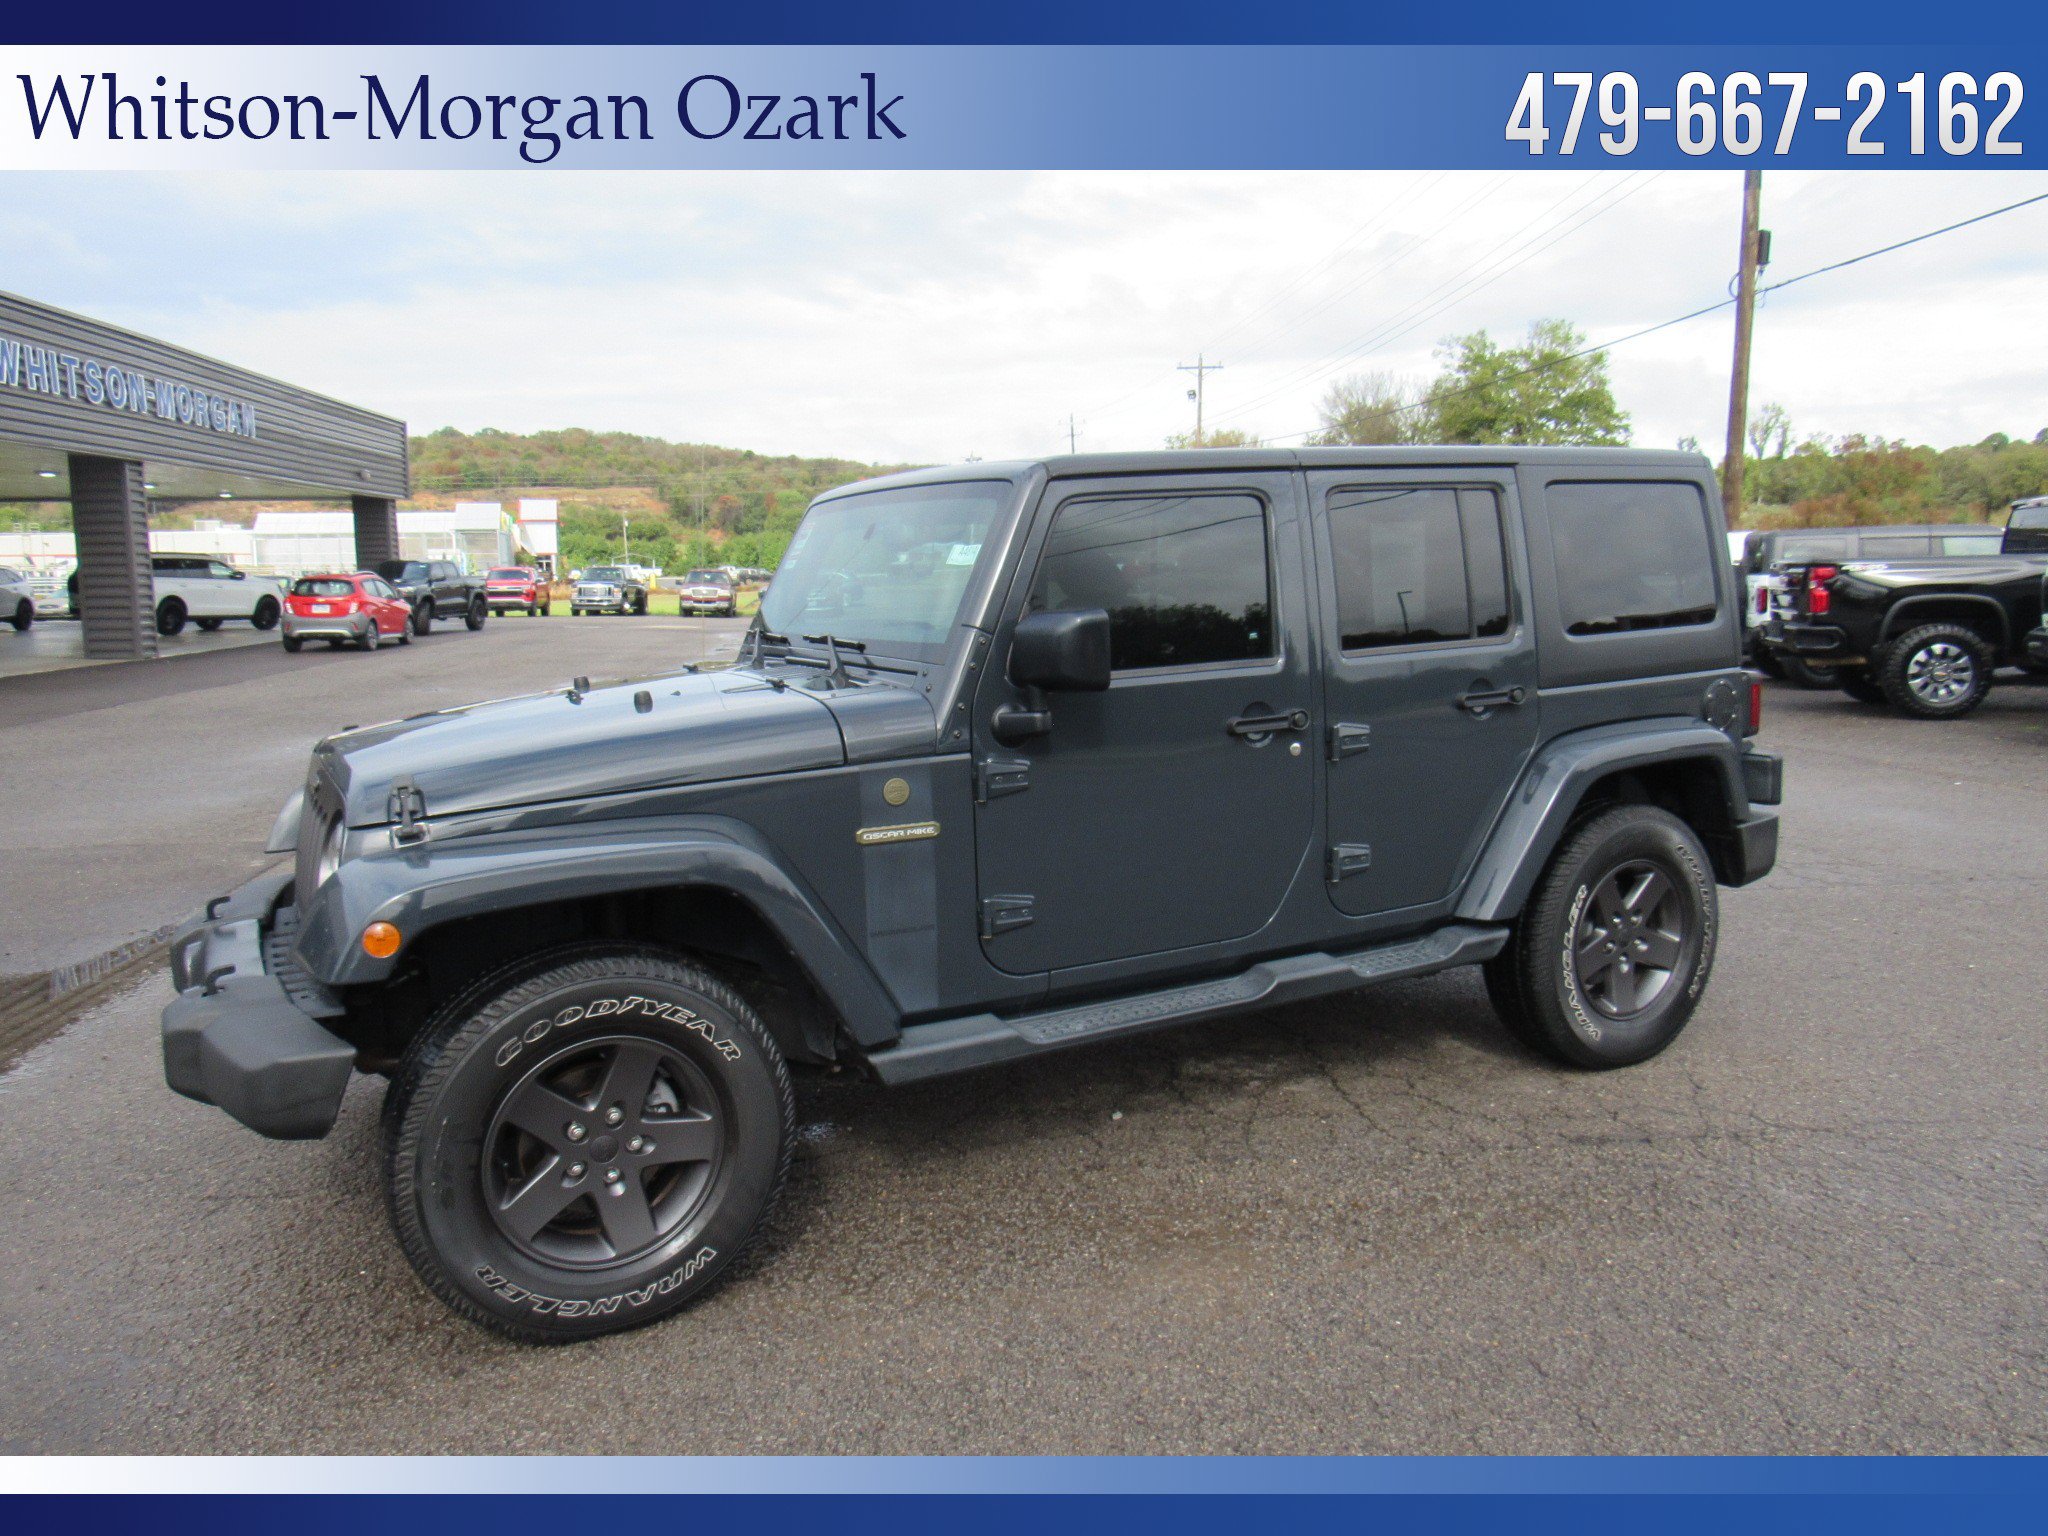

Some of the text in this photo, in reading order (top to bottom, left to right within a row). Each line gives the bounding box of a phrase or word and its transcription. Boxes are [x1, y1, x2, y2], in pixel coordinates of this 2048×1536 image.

[863, 826, 935, 841] OSCAR MIKE
[1562, 884, 1602, 1041] WRANGLER
[495, 996, 742, 1067] GOODYEAR
[475, 1246, 717, 1317] WRANGLER
